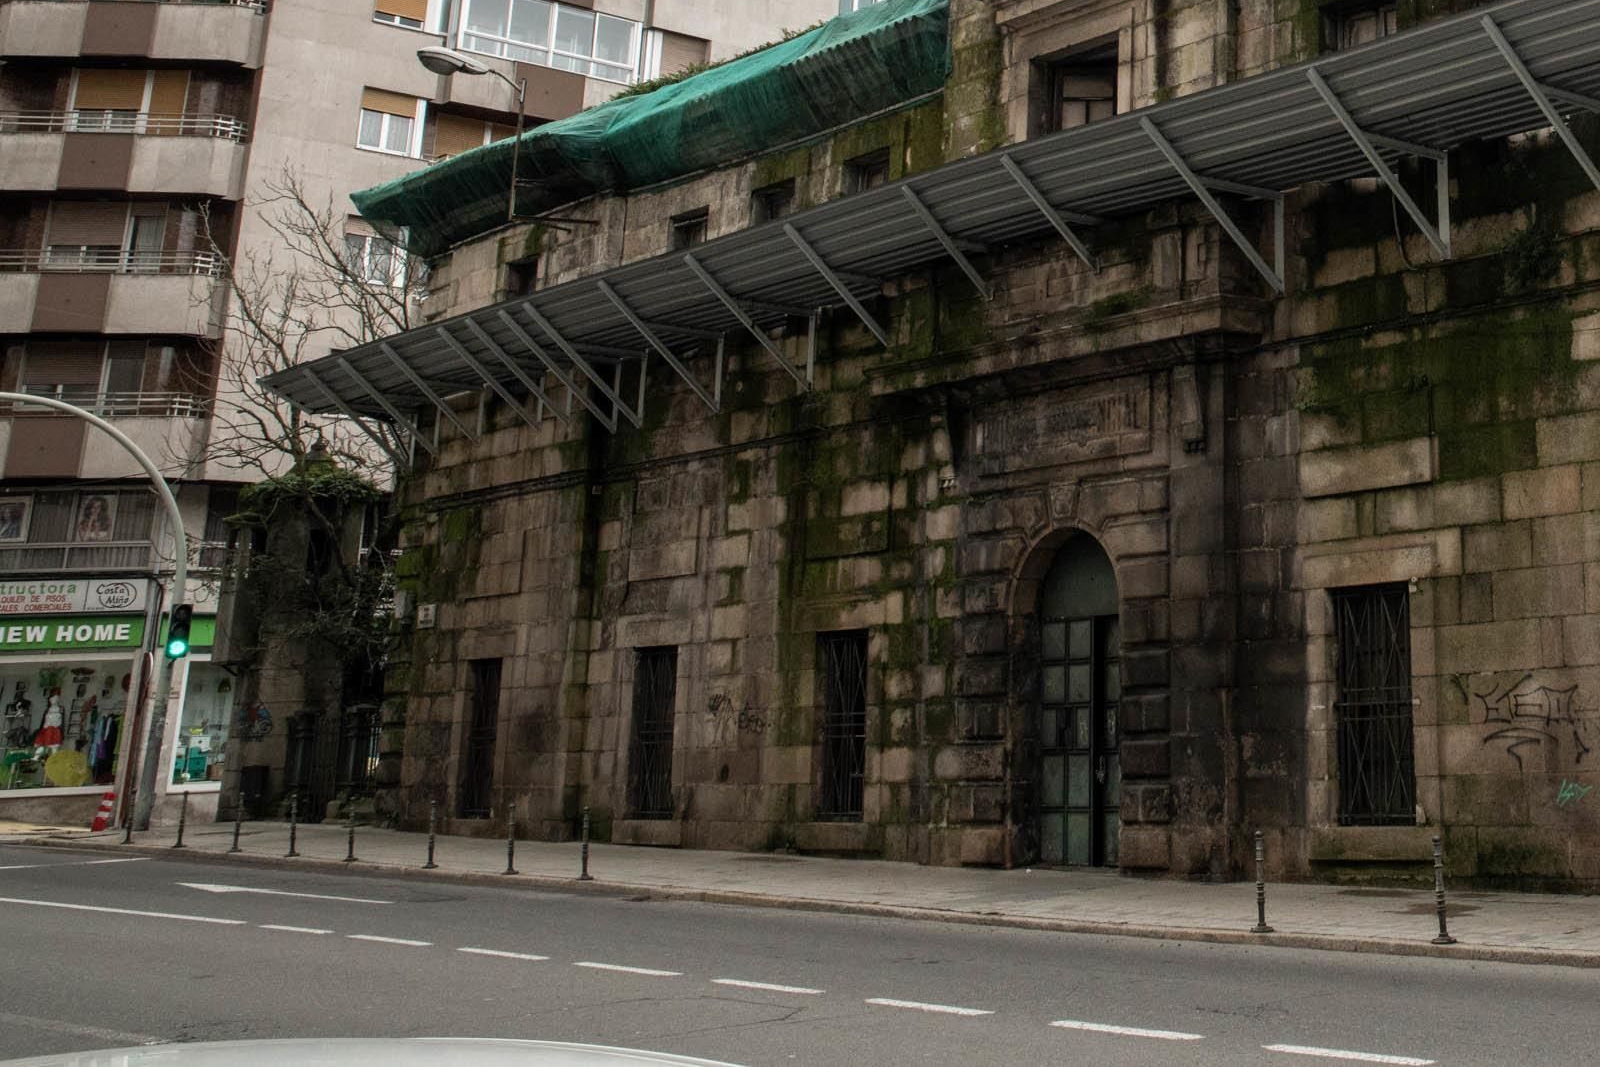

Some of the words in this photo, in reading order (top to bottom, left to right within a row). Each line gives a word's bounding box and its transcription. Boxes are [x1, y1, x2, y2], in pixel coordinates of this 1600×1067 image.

[31, 594, 41, 603] DE
[46, 594, 67, 603] PISOS
[24, 603, 73, 611] COMERCIALES
[56, 623, 131, 642] HOME
